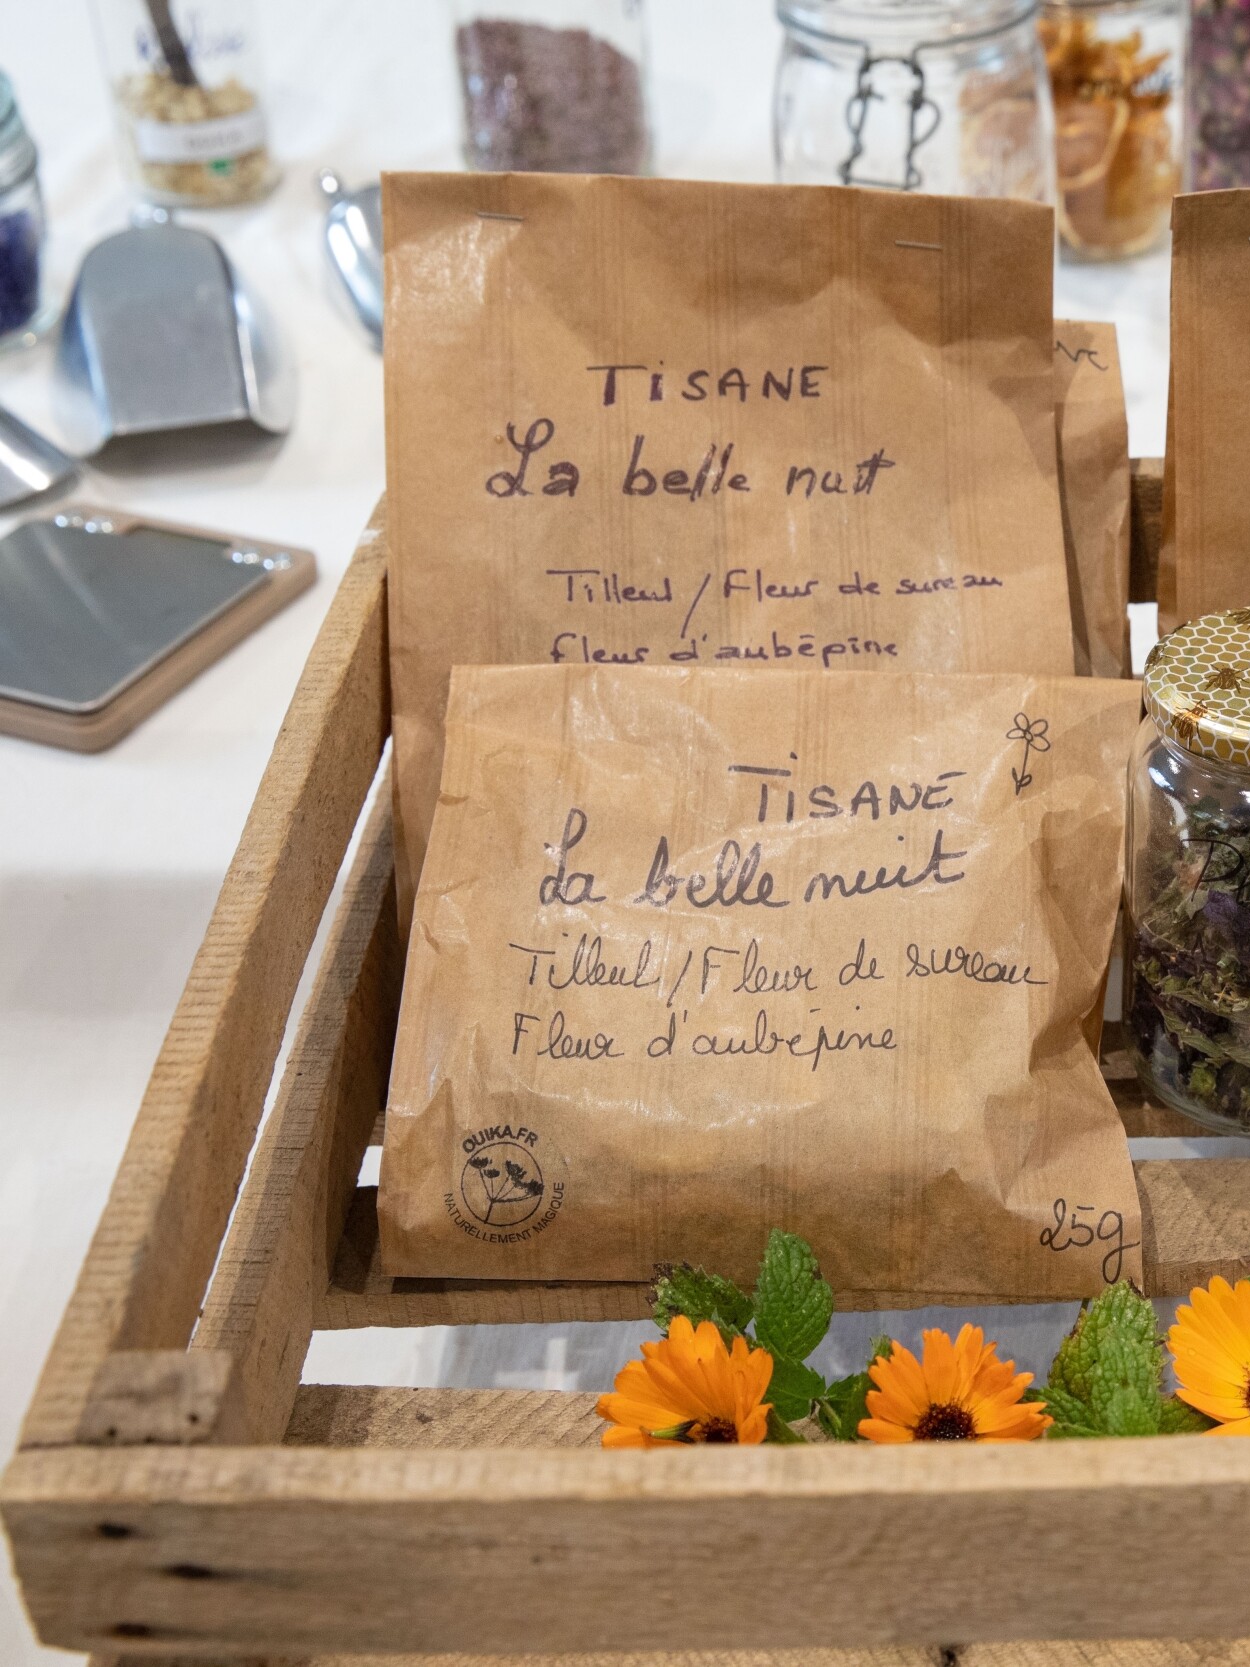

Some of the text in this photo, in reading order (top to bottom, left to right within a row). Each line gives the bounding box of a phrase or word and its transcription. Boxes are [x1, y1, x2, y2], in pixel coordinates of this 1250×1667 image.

[485, 418, 580, 497] La
[622, 436, 751, 502] belle
[838, 571, 881, 595] de
[539, 808, 968, 909] La belle nuit
[839, 938, 885, 984] de
[907, 942, 1049, 985] sureau
[512, 1010, 625, 1060] Fleur
[462, 1125, 539, 1154] OUIKA.FR
[444, 1182, 565, 1244] NATURELLEMENT MAGIQUE
